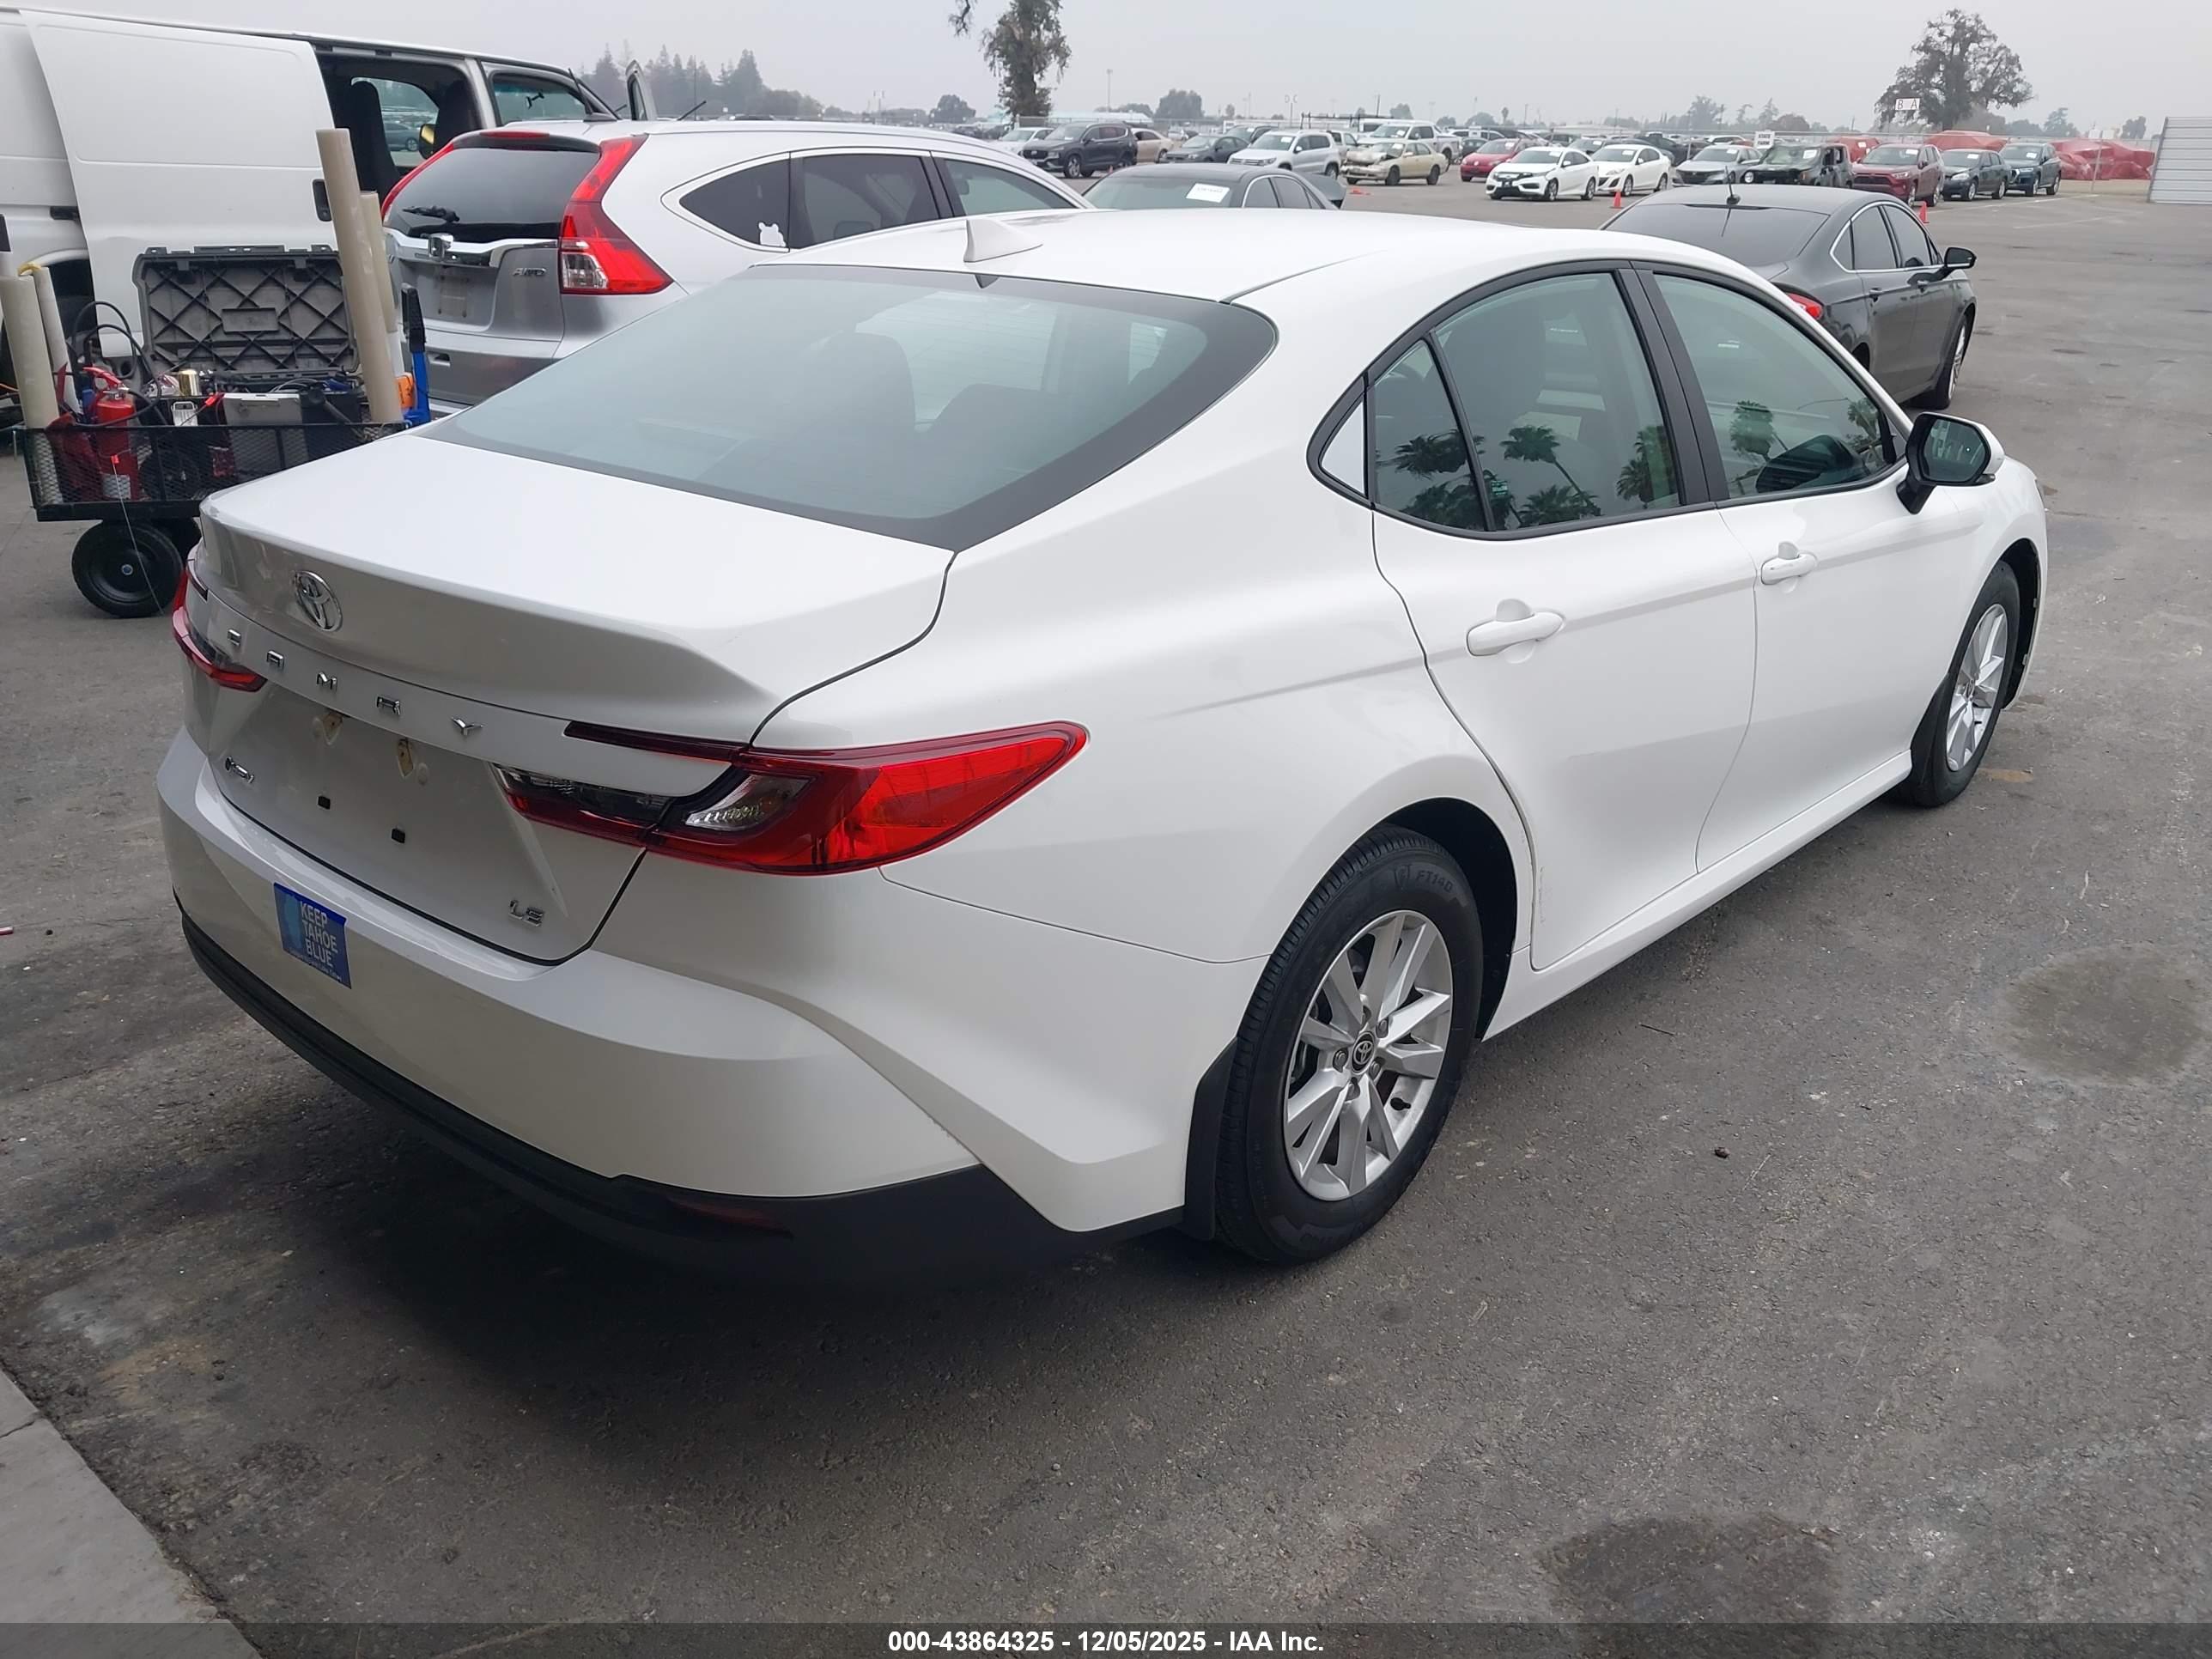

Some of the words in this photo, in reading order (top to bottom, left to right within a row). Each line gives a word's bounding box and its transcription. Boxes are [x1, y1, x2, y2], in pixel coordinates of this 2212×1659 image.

[1898, 99, 1904, 110] B
[1910, 98, 1917, 110] A
[513, 267, 547, 276] AWD
[227, 629, 483, 736] CAMRY
[300, 901, 328, 927] KEEP
[508, 900, 544, 927] LE
[301, 919, 339, 954] TAHOE
[305, 938, 334, 968] BLUE
